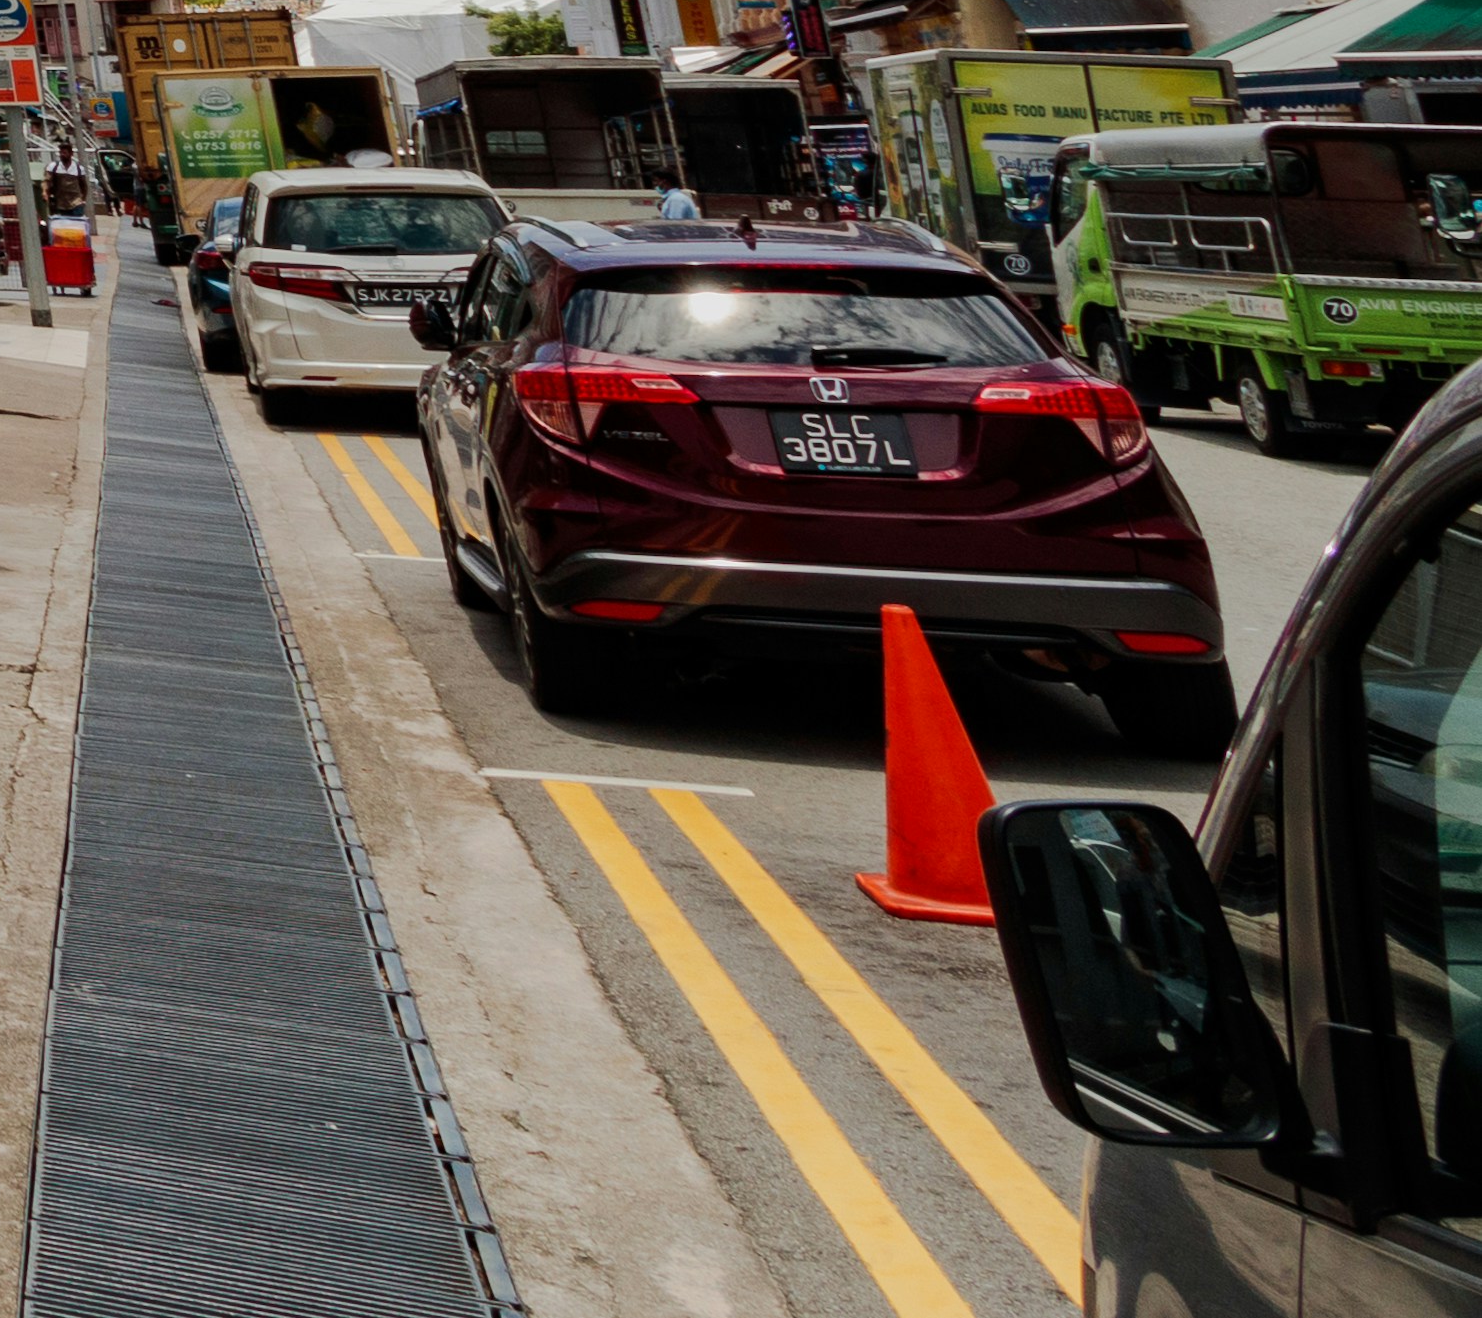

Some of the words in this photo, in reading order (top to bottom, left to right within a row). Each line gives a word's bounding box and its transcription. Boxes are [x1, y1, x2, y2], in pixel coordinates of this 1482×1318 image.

[971, 102, 1008, 116] ALVAS
[1013, 104, 1046, 118] FOOD
[1052, 105, 1087, 120] MANU
[1096, 108, 1154, 124] FACTURE
[1160, 112, 1185, 125] PTE
[1190, 113, 1215, 126] LTD
[193, 130, 223, 140] 6257
[228, 129, 259, 139] 3712
[195, 141, 227, 151] 6753
[1009, 257, 1026, 273] 70
[357, 288, 450, 303] SJK2752Z
[1326, 302, 1352, 317] 70
[1358, 298, 1397, 311] AVM
[802, 414, 875, 439] SLC
[603, 429, 670, 442] VEZEL
[783, 438, 911, 466] 3807L
